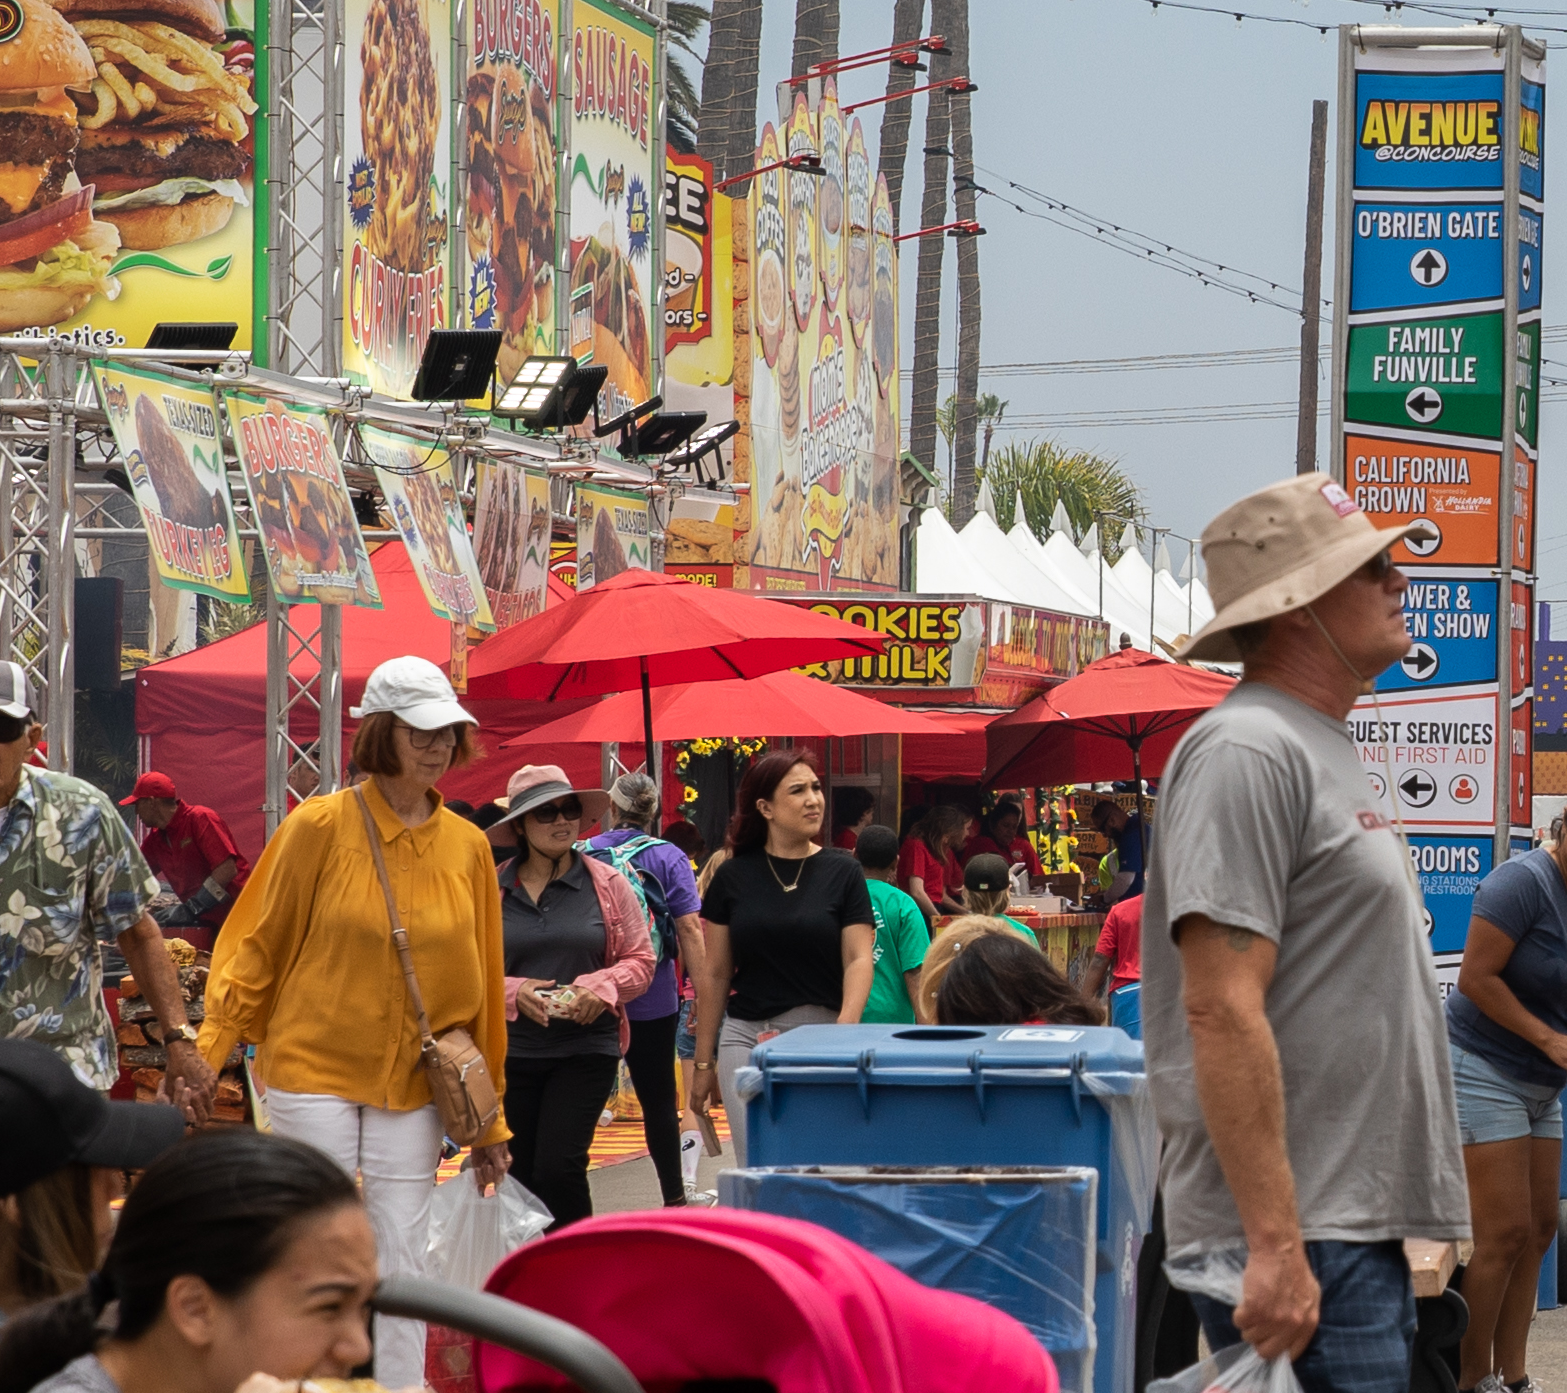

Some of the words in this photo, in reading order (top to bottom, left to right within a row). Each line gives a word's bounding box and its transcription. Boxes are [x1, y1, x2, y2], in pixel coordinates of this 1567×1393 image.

[575, 25, 650, 151] SAUSAGE
[1361, 101, 1501, 150] AVENUE
[1375, 144, 1501, 162] @CONCOURSE
[756, 203, 784, 259] COFFEE
[1358, 211, 1442, 239] O'BRIEN
[1447, 211, 1500, 239] GATE
[349, 239, 405, 375] CURLY
[1387, 325, 1465, 355] FAMILY
[1372, 355, 1477, 383] FUNVILLE
[240, 411, 342, 489] BURGERS
[1354, 454, 1471, 485] CALIFORNIA
[1354, 484, 1427, 515] GROWN
[1455, 584, 1472, 610] &
[1433, 612, 1491, 639] SHOW
[841, 646, 952, 682] MILK
[1347, 720, 1401, 743] GUEST
[1406, 721, 1494, 746] SERVICES
[1395, 746, 1449, 765] FIRST
[1455, 747, 1488, 765] AID
[1431, 875, 1480, 887] STATIONS
